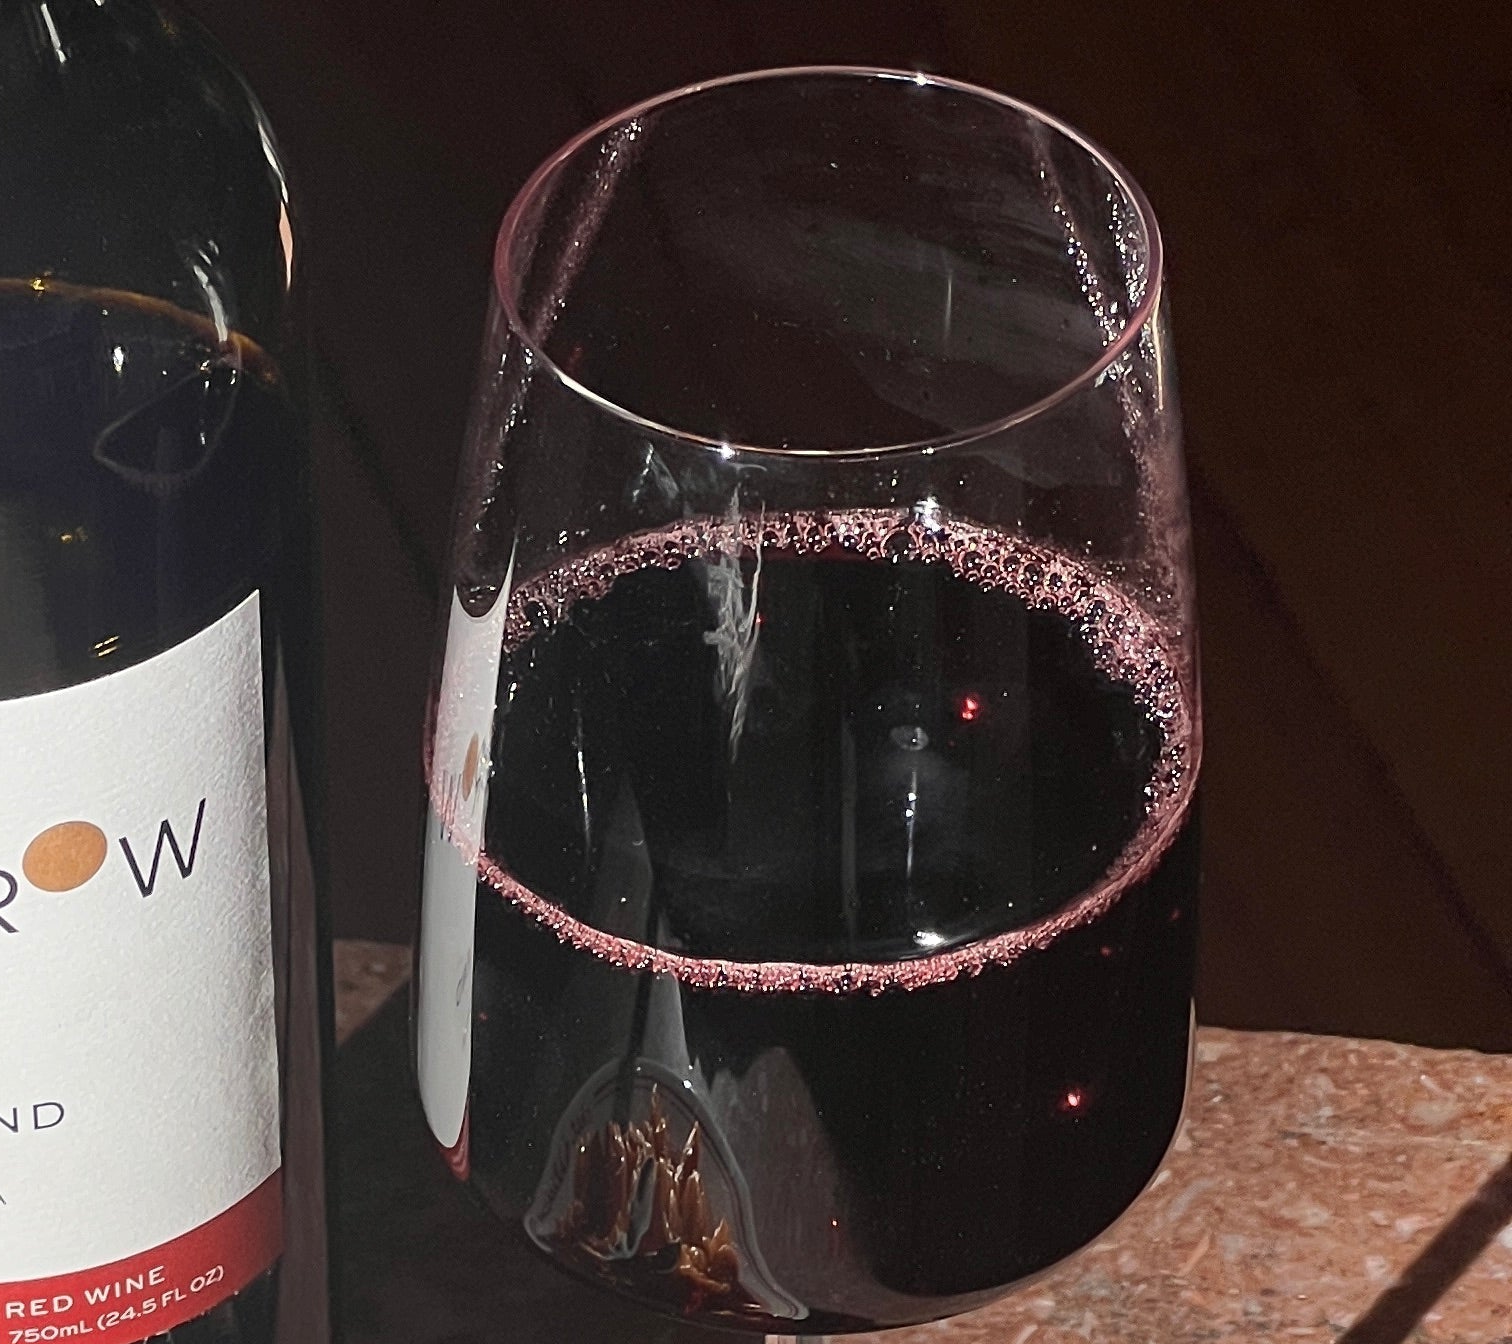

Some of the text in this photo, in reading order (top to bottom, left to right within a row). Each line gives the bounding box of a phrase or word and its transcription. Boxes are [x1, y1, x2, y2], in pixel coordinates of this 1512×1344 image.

[4, 1294, 74, 1320] RED
[83, 1265, 167, 1307] WINE
[95, 1297, 158, 1333] (24.5
[160, 1287, 188, 1309] FL
[189, 1264, 226, 1294] OZ)
